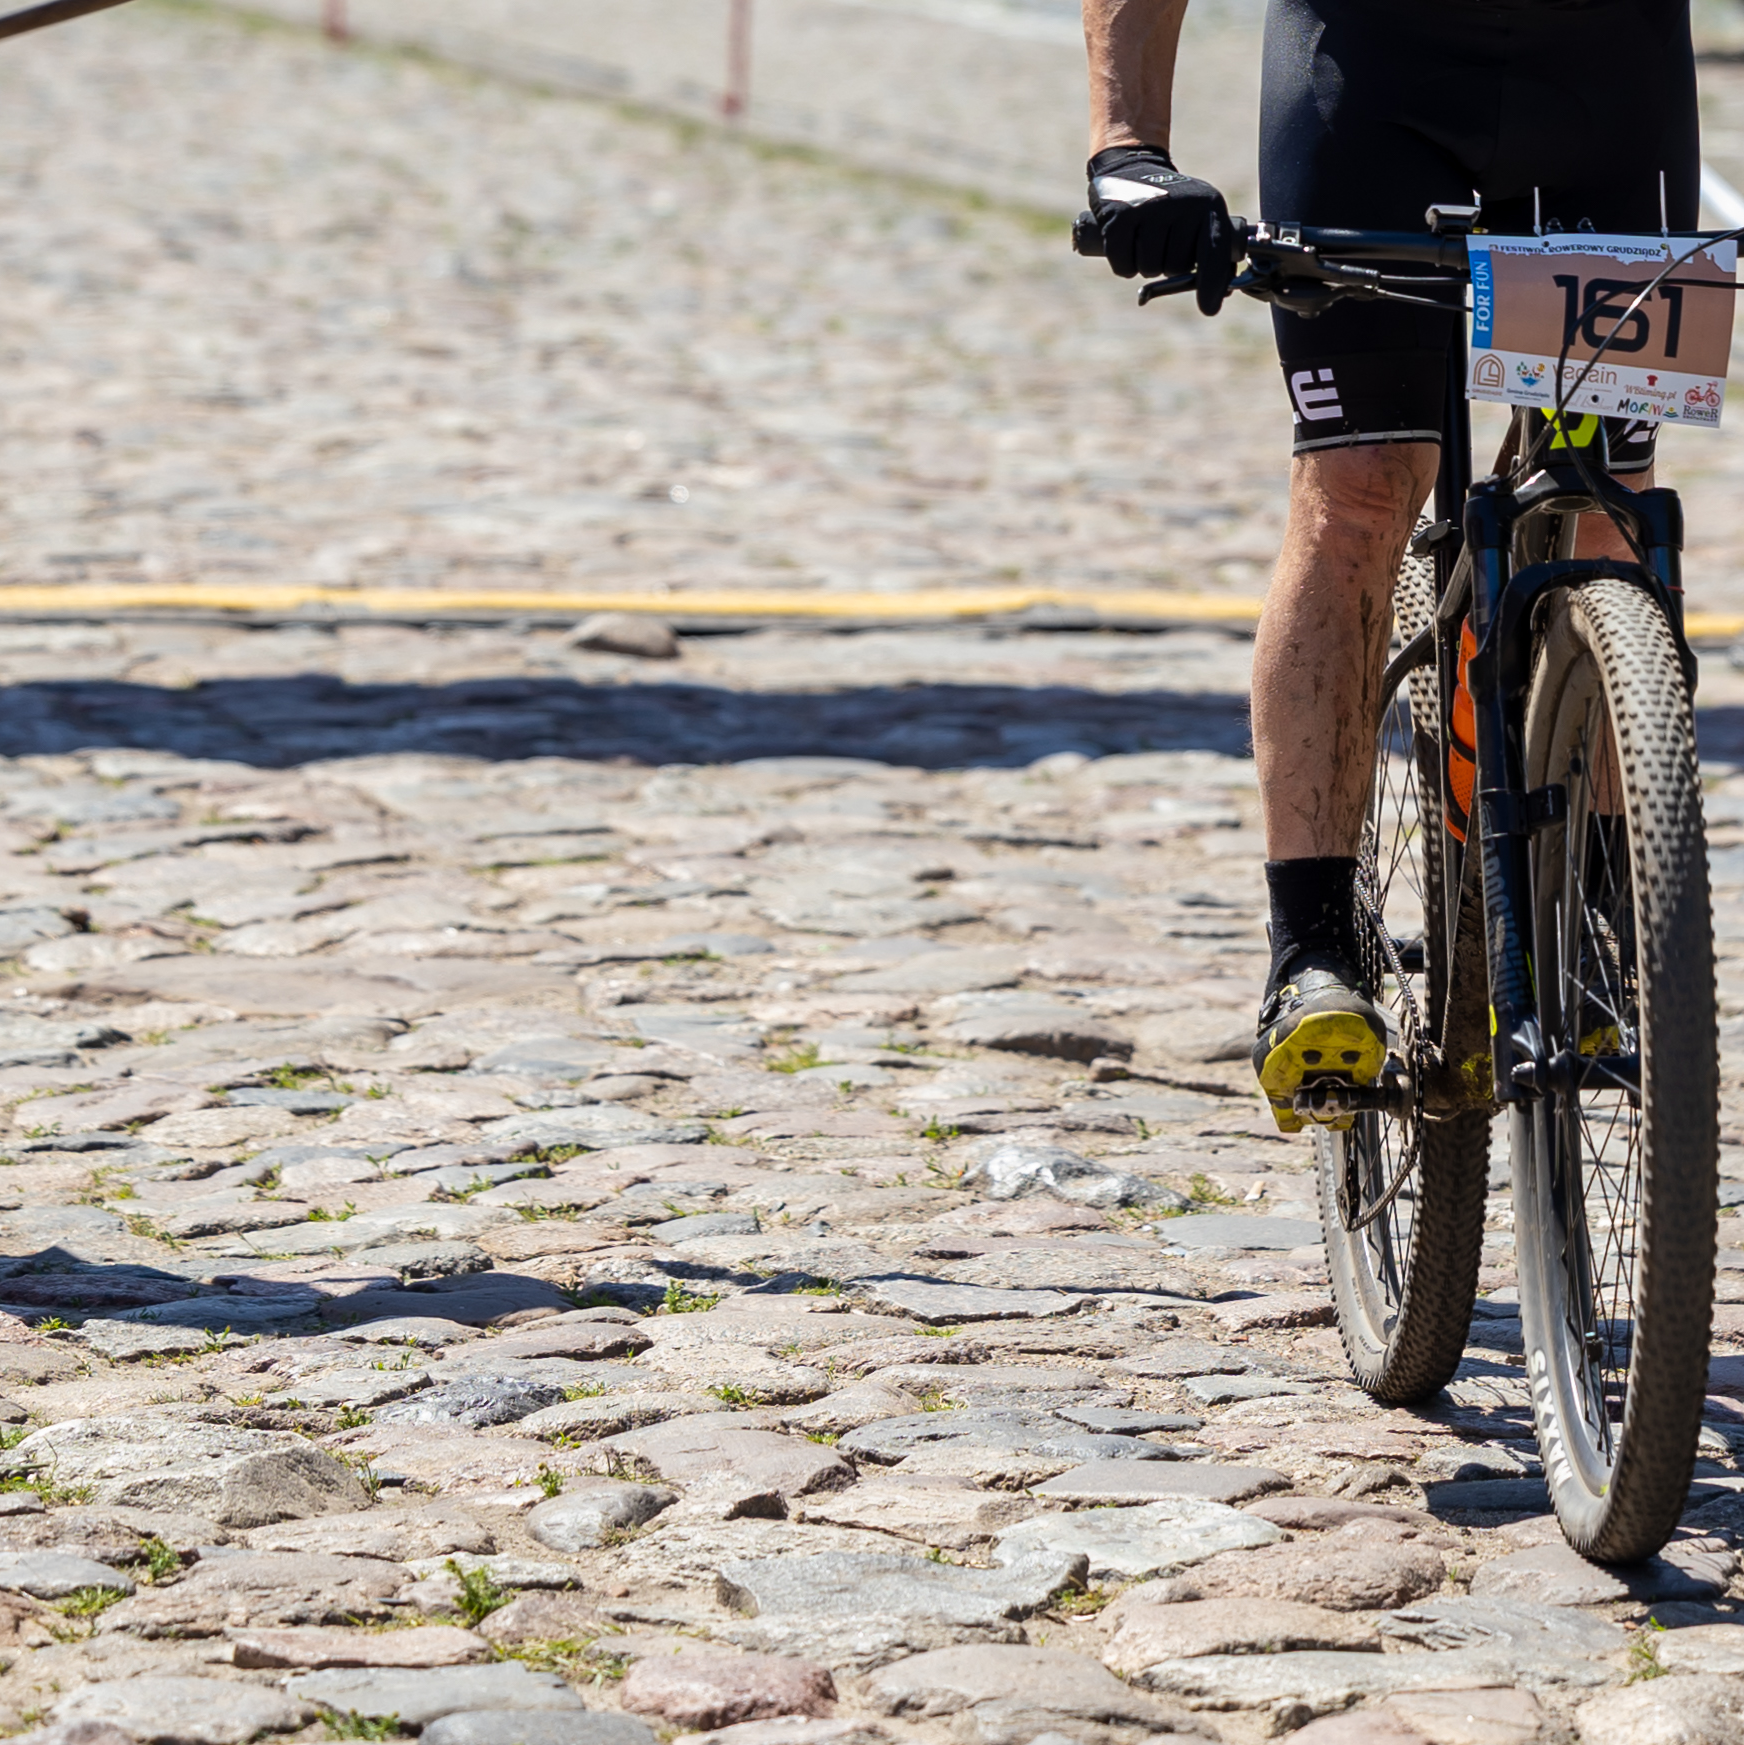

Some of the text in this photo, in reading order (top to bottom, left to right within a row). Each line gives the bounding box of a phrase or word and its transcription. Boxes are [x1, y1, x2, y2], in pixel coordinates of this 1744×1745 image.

[1548, 243, 1605, 254] ROWEROWY
[1606, 244, 1662, 259] GRUDZIĄDZ
[1474, 261, 1491, 332] FOR FUN
[1552, 273, 1683, 359] 161
[1324, 1173, 1340, 1230] KENDA
[1530, 1348, 1573, 1489] MAXXIS
